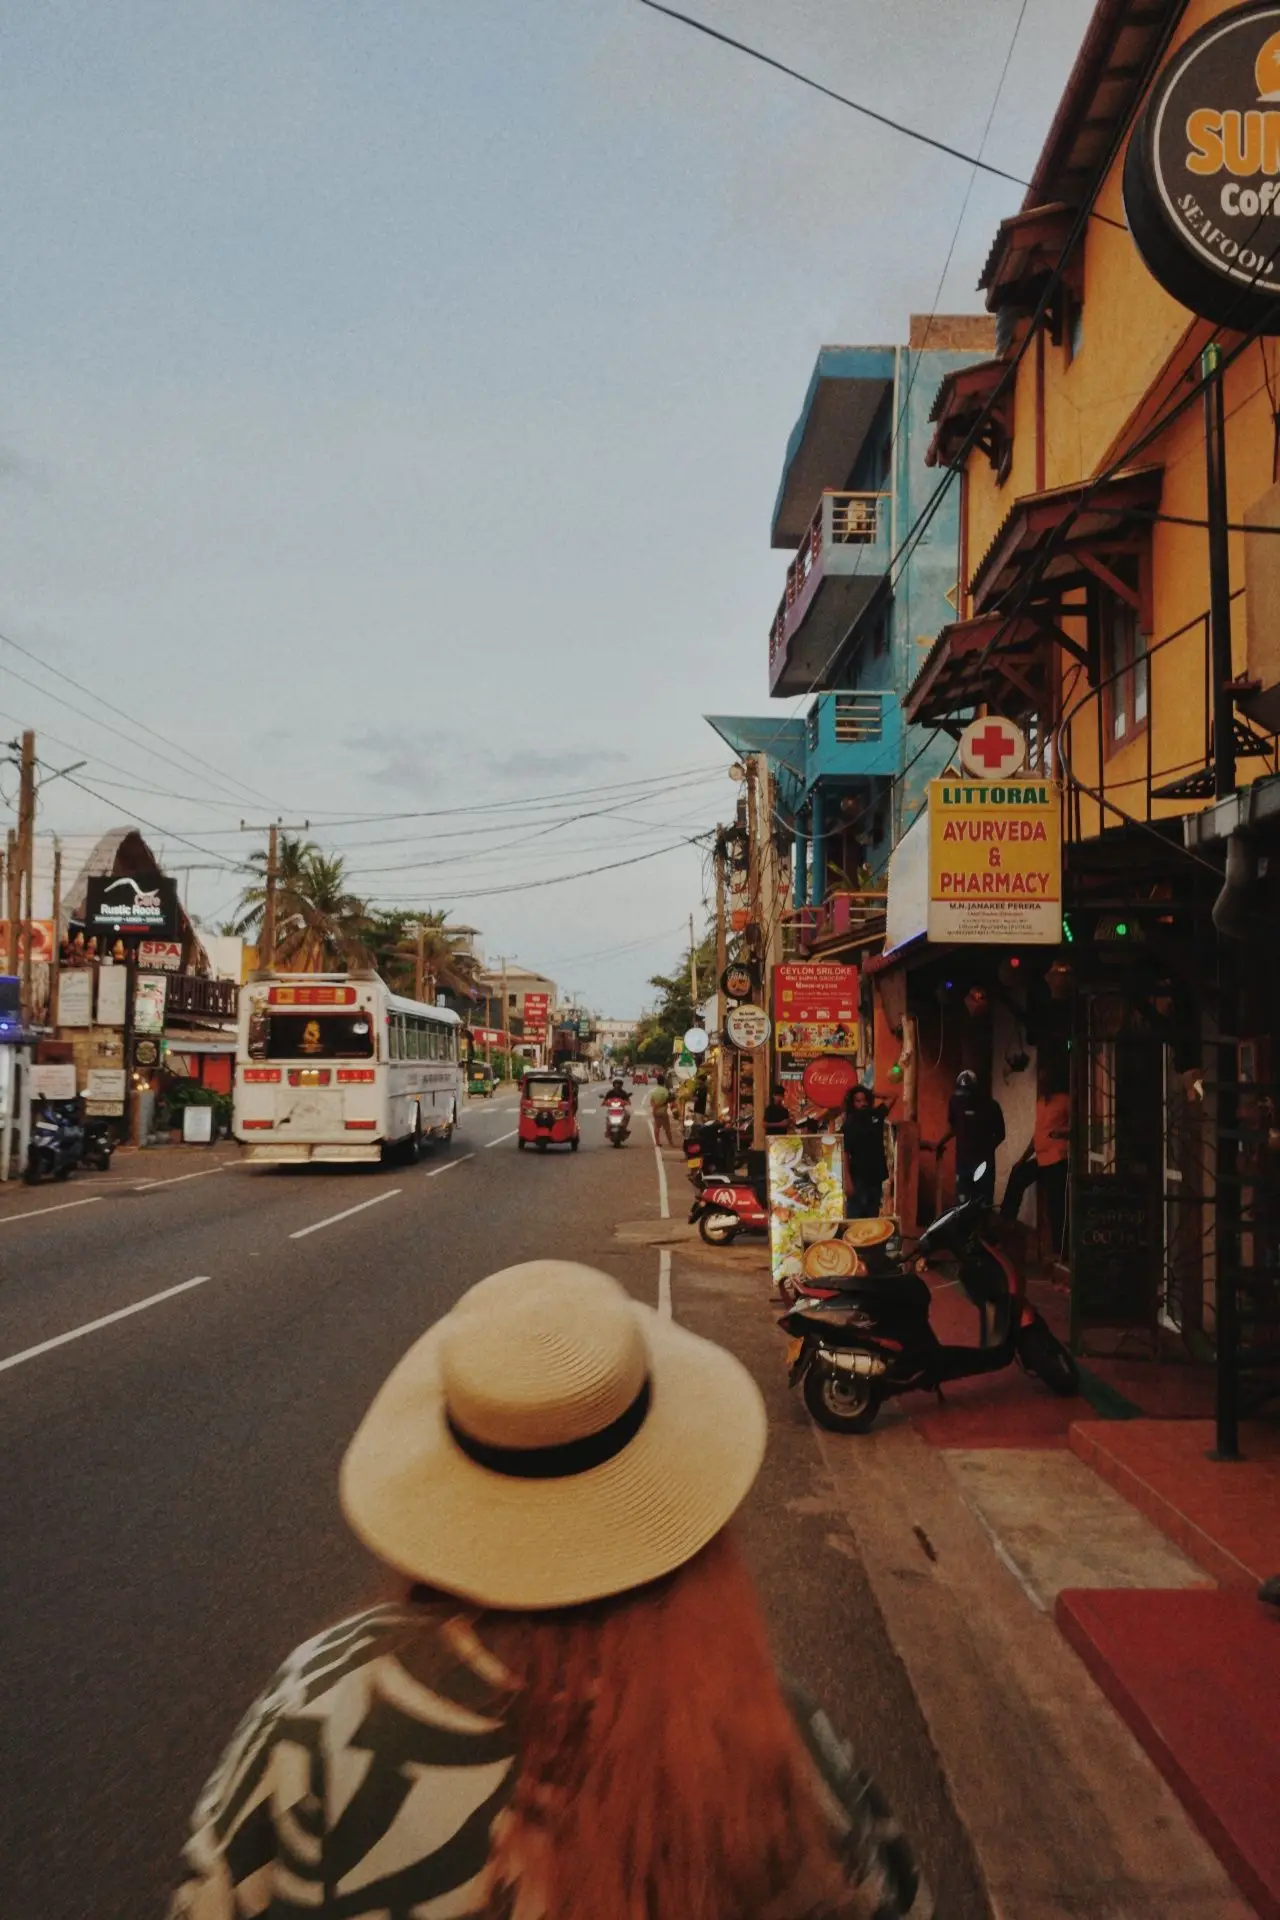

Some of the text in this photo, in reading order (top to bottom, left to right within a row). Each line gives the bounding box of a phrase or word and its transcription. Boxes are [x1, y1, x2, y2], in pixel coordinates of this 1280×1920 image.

[1177, 193, 1275, 275] SEAFOOD
[943, 787, 1049, 804] LITTORAL
[943, 820, 1048, 842] AYURVEDA
[988, 847, 1002, 867] &
[940, 872, 1050, 894] PHARMACY
[100, 903, 161, 915] Rustic Roots
[142, 942, 180, 957] SPA
[780, 967, 814, 975] CEYLON
